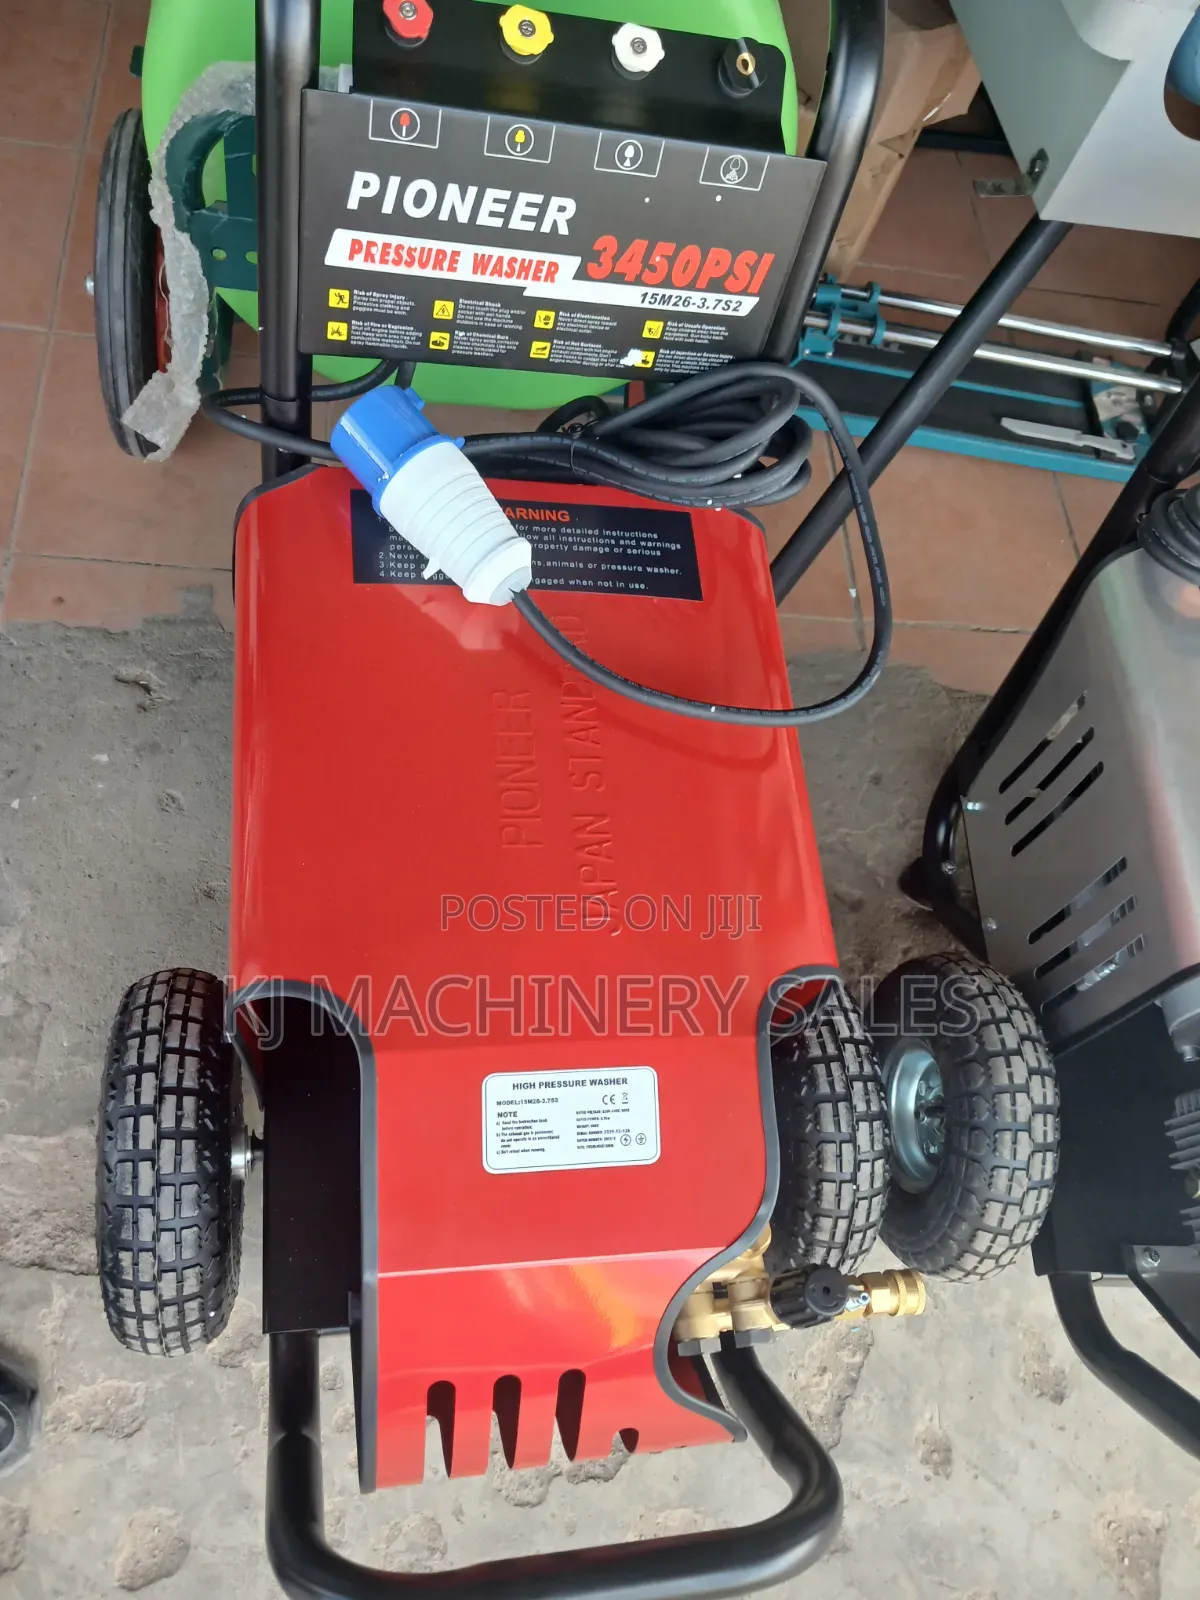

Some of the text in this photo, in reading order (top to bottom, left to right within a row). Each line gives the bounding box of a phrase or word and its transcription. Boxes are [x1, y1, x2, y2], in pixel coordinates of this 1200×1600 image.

[346, 170, 577, 235] PIONEER
[348, 238, 559, 284] PRESSURE WASHER
[586, 235, 775, 293] 3450PSI
[640, 291, 742, 312] 15M26-3.7S2
[503, 507, 570, 522] ARNING
[561, 526, 598, 536] detailed
[603, 529, 658, 539] instructions
[559, 536, 616, 544] instructions
[640, 540, 681, 550] warnings
[572, 545, 610, 554] damage
[602, 564, 642, 572] pressure
[646, 566, 682, 575] washer.
[492, 690, 544, 848] PIONEER
[571, 813, 622, 937] JAPAN
[512, 1078, 628, 1090] HIGH PRESSURE WASHER
[498, 1110, 518, 1118] NOTE
